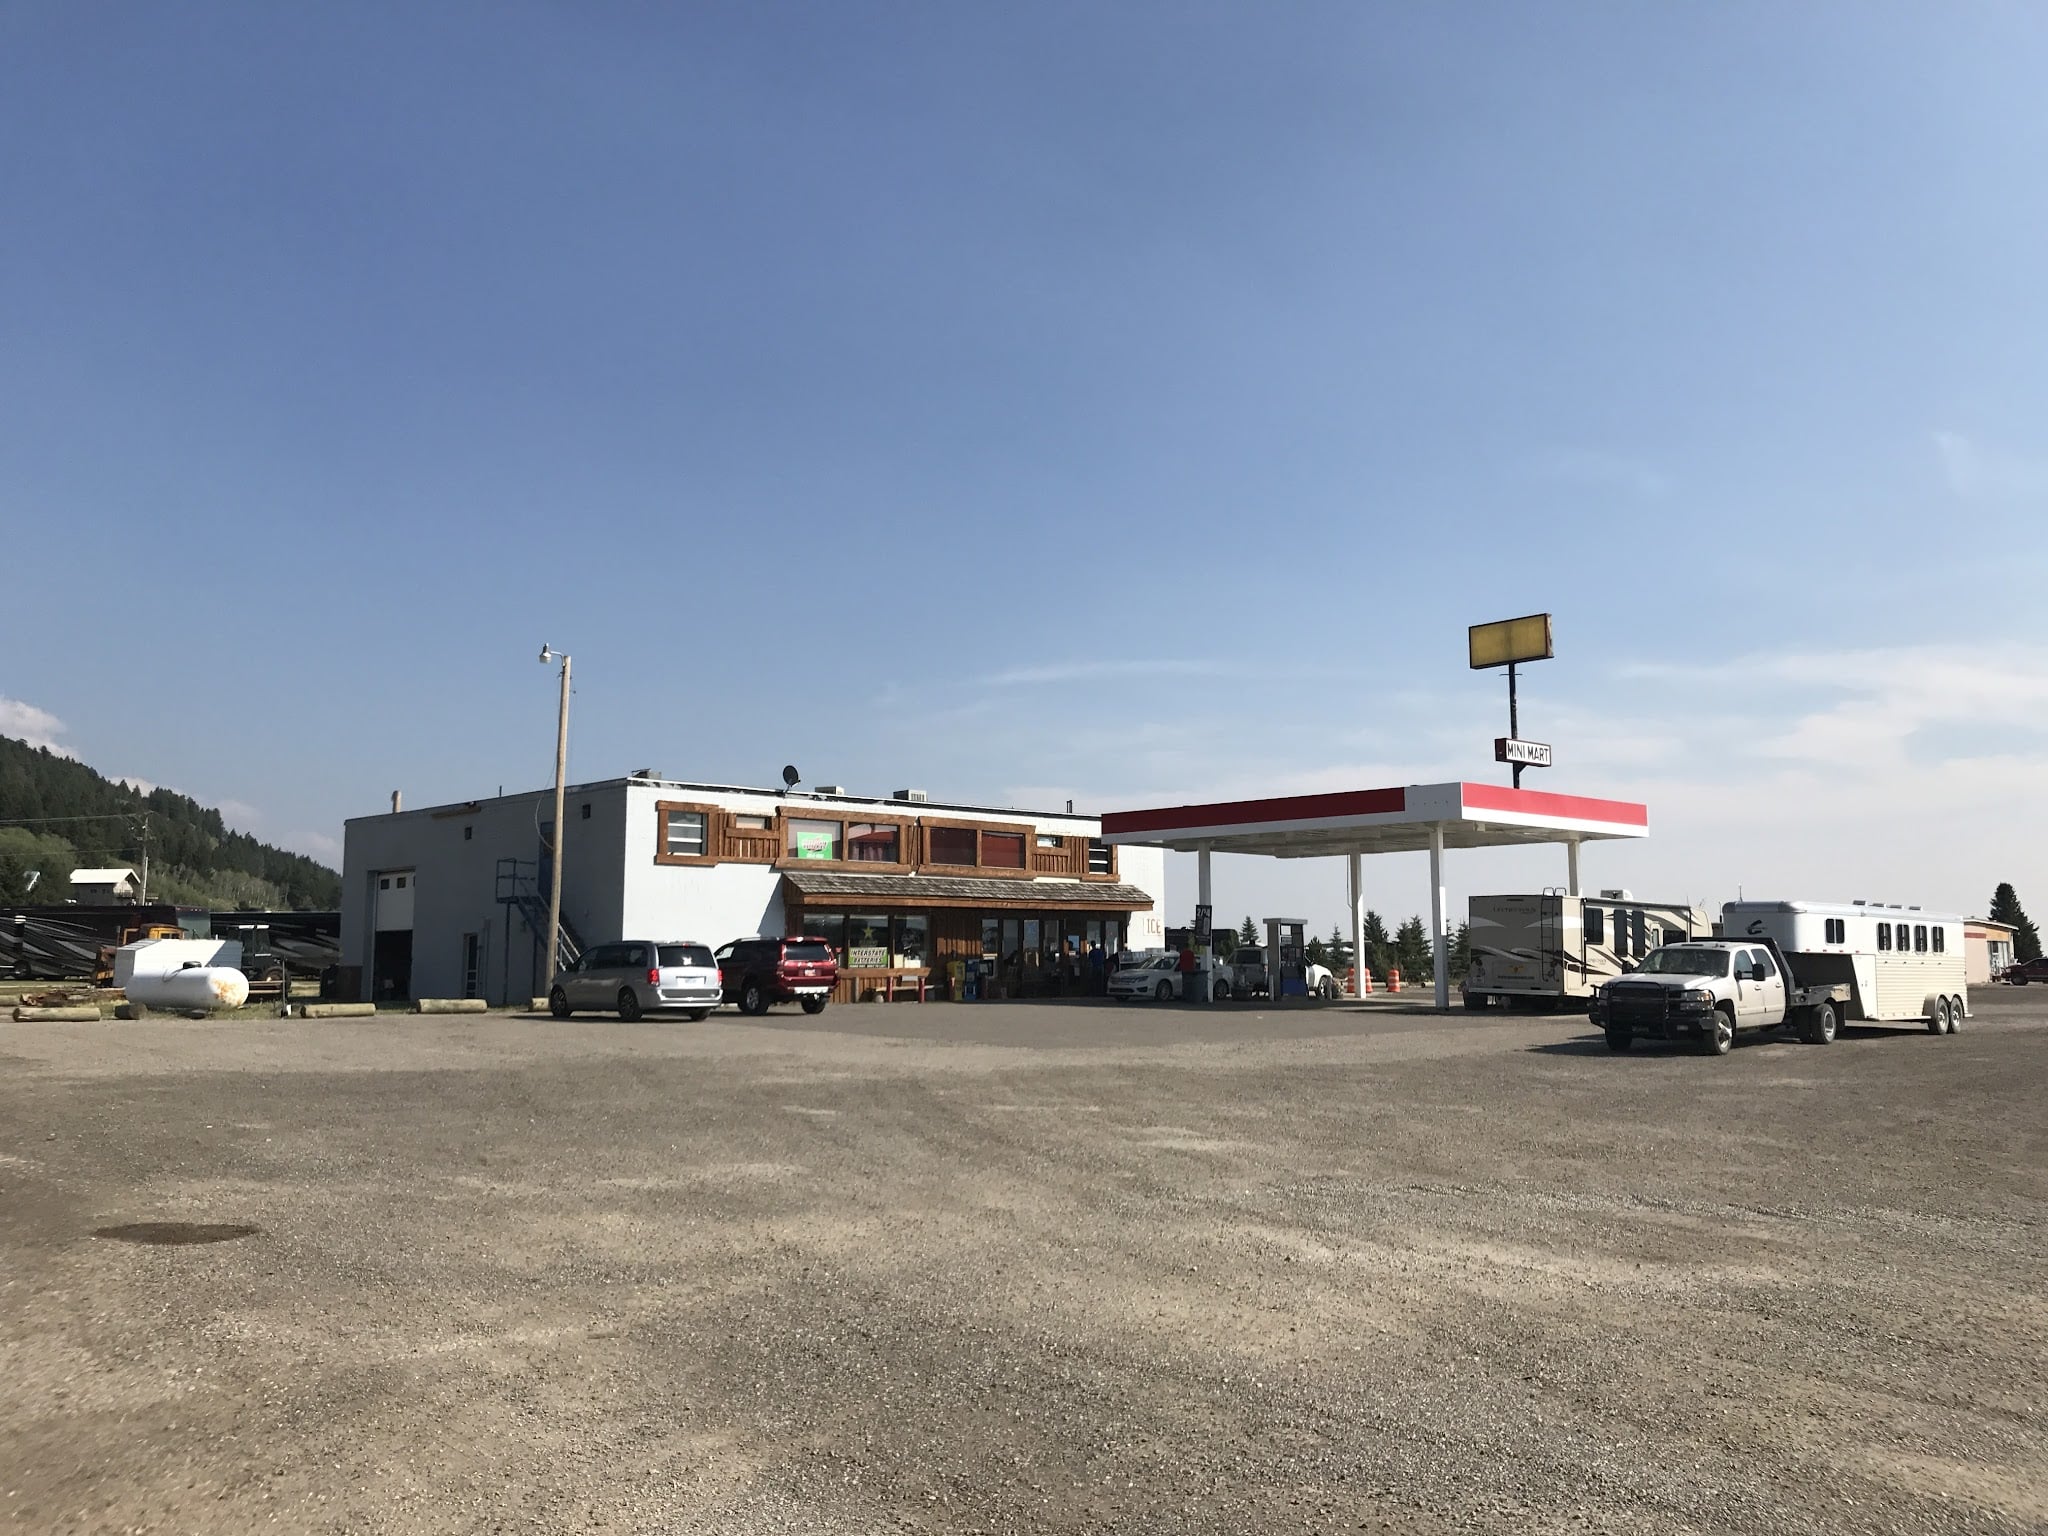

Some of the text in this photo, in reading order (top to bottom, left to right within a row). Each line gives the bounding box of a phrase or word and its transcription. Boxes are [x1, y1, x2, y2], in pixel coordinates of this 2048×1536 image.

[1507, 742, 1549, 763] MINI MART
[1147, 918, 1161, 934] ICE
[850, 949, 886, 957] INTERSTATE
[854, 956, 882, 964] BATTERIES
